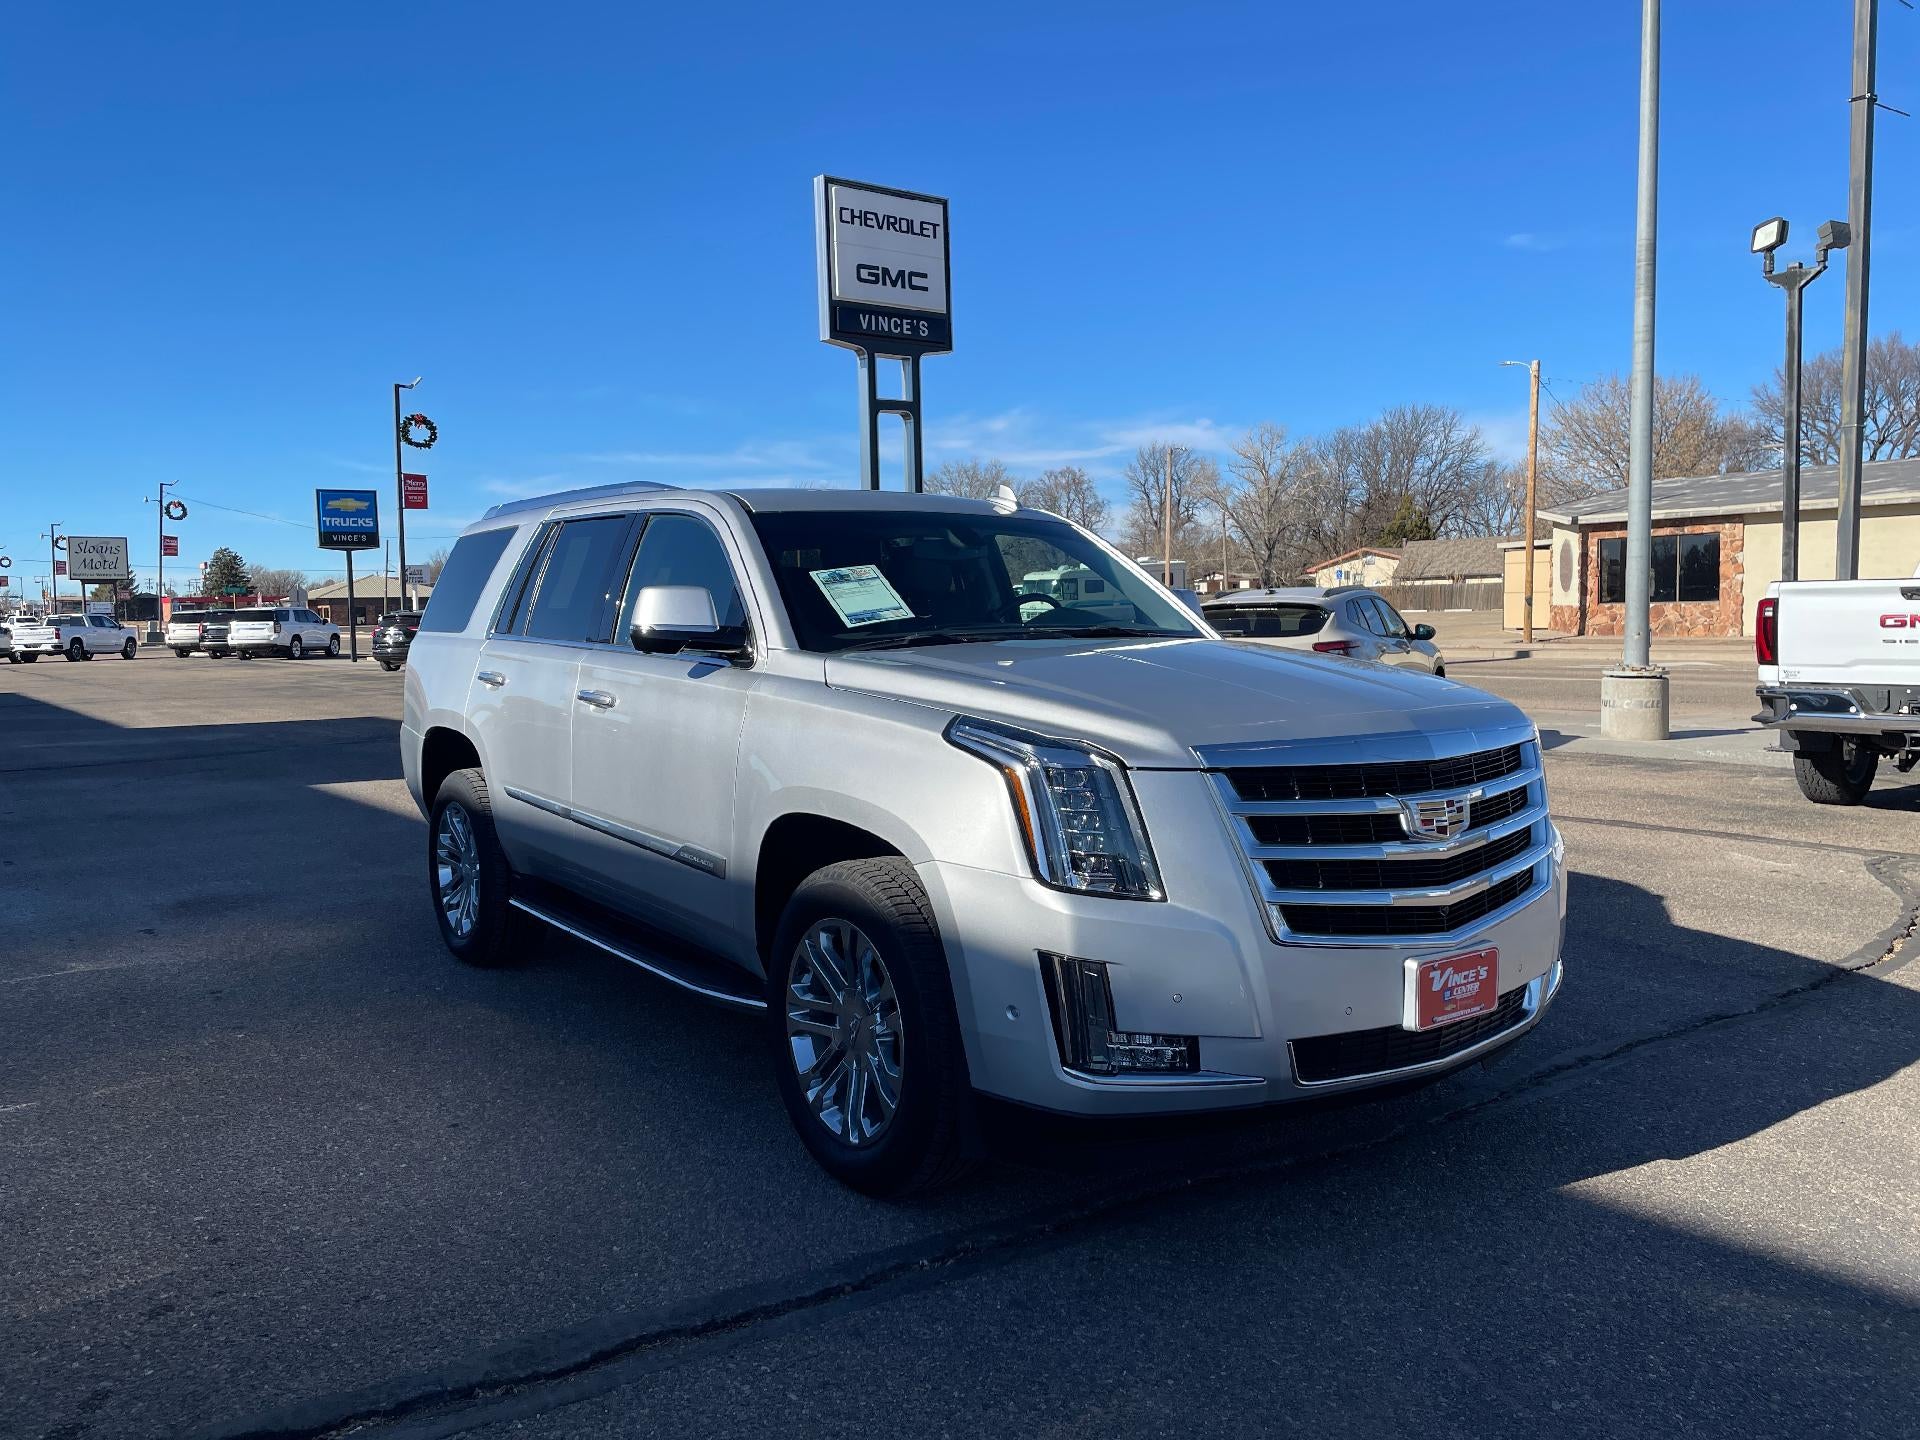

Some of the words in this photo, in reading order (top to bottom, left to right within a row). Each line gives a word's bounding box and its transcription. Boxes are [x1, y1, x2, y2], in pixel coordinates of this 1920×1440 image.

[839, 206, 940, 240] CHEVROLET
[856, 263, 929, 292] GMC
[859, 313, 929, 337] VINCE'S
[322, 517, 374, 527] TRUCKS
[74, 540, 121, 555] Sloans
[332, 534, 367, 542] VINCE'S
[78, 556, 119, 570] Motel
[1429, 966, 1489, 992] VINCE'S
